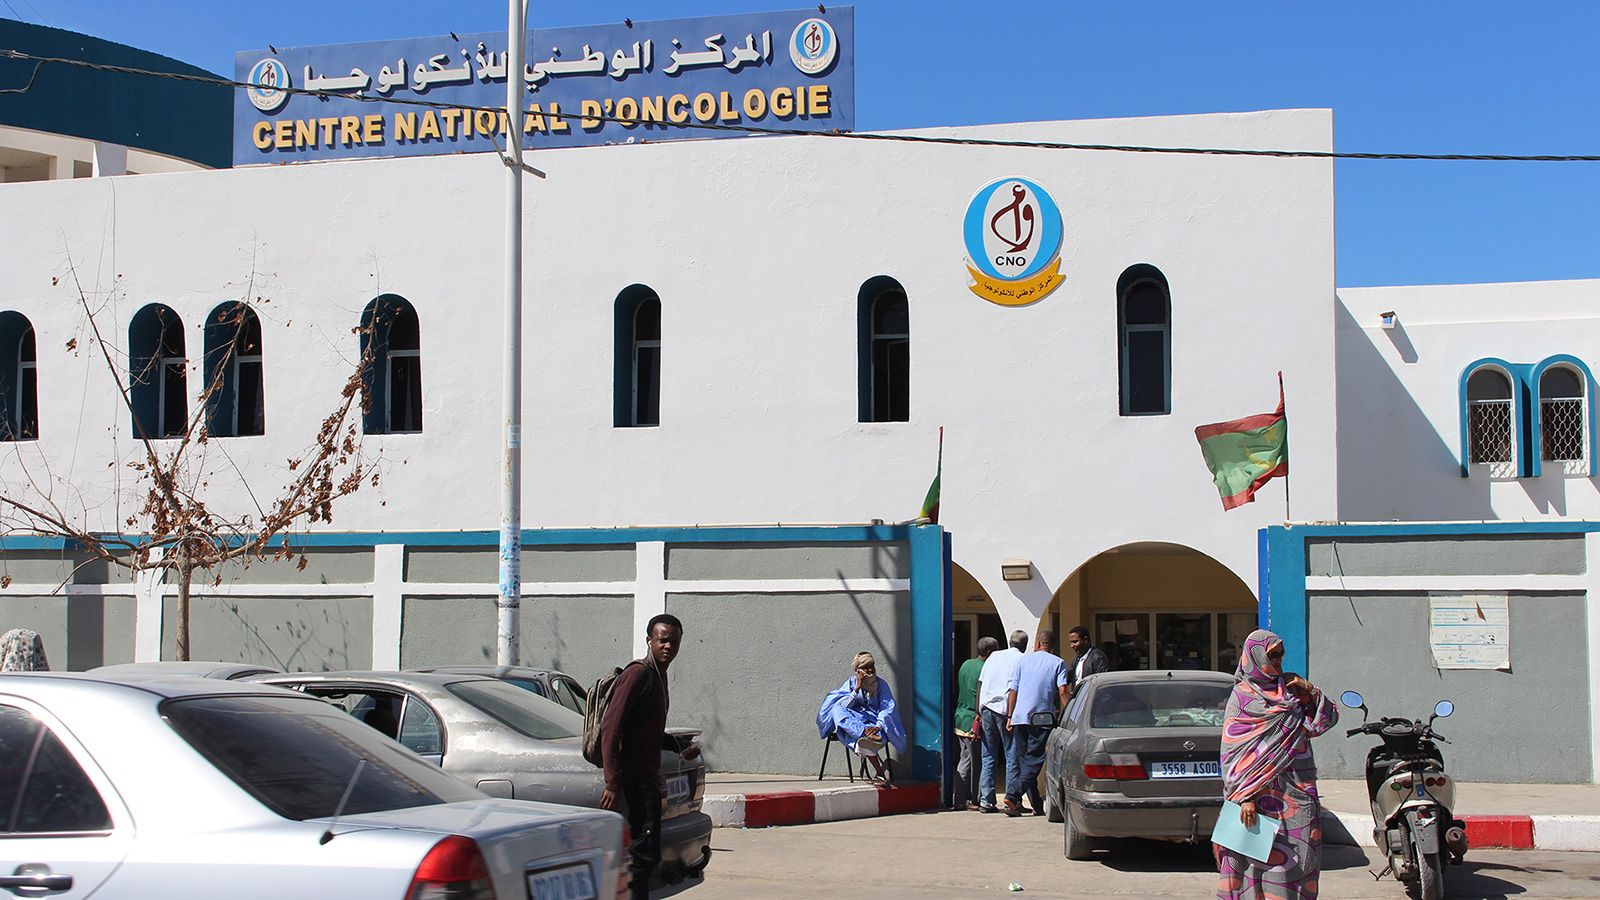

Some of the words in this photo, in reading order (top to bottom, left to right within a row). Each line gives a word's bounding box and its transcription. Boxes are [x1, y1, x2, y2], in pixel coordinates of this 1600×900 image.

[524, 39, 652, 90] الوطني
[663, 30, 771, 74] المركز
[252, 114, 382, 149] CENTRE
[581, 85, 829, 129] D'ONCOLOGIE
[995, 256, 1026, 267] CNO
[1161, 763, 1186, 775] 3558
